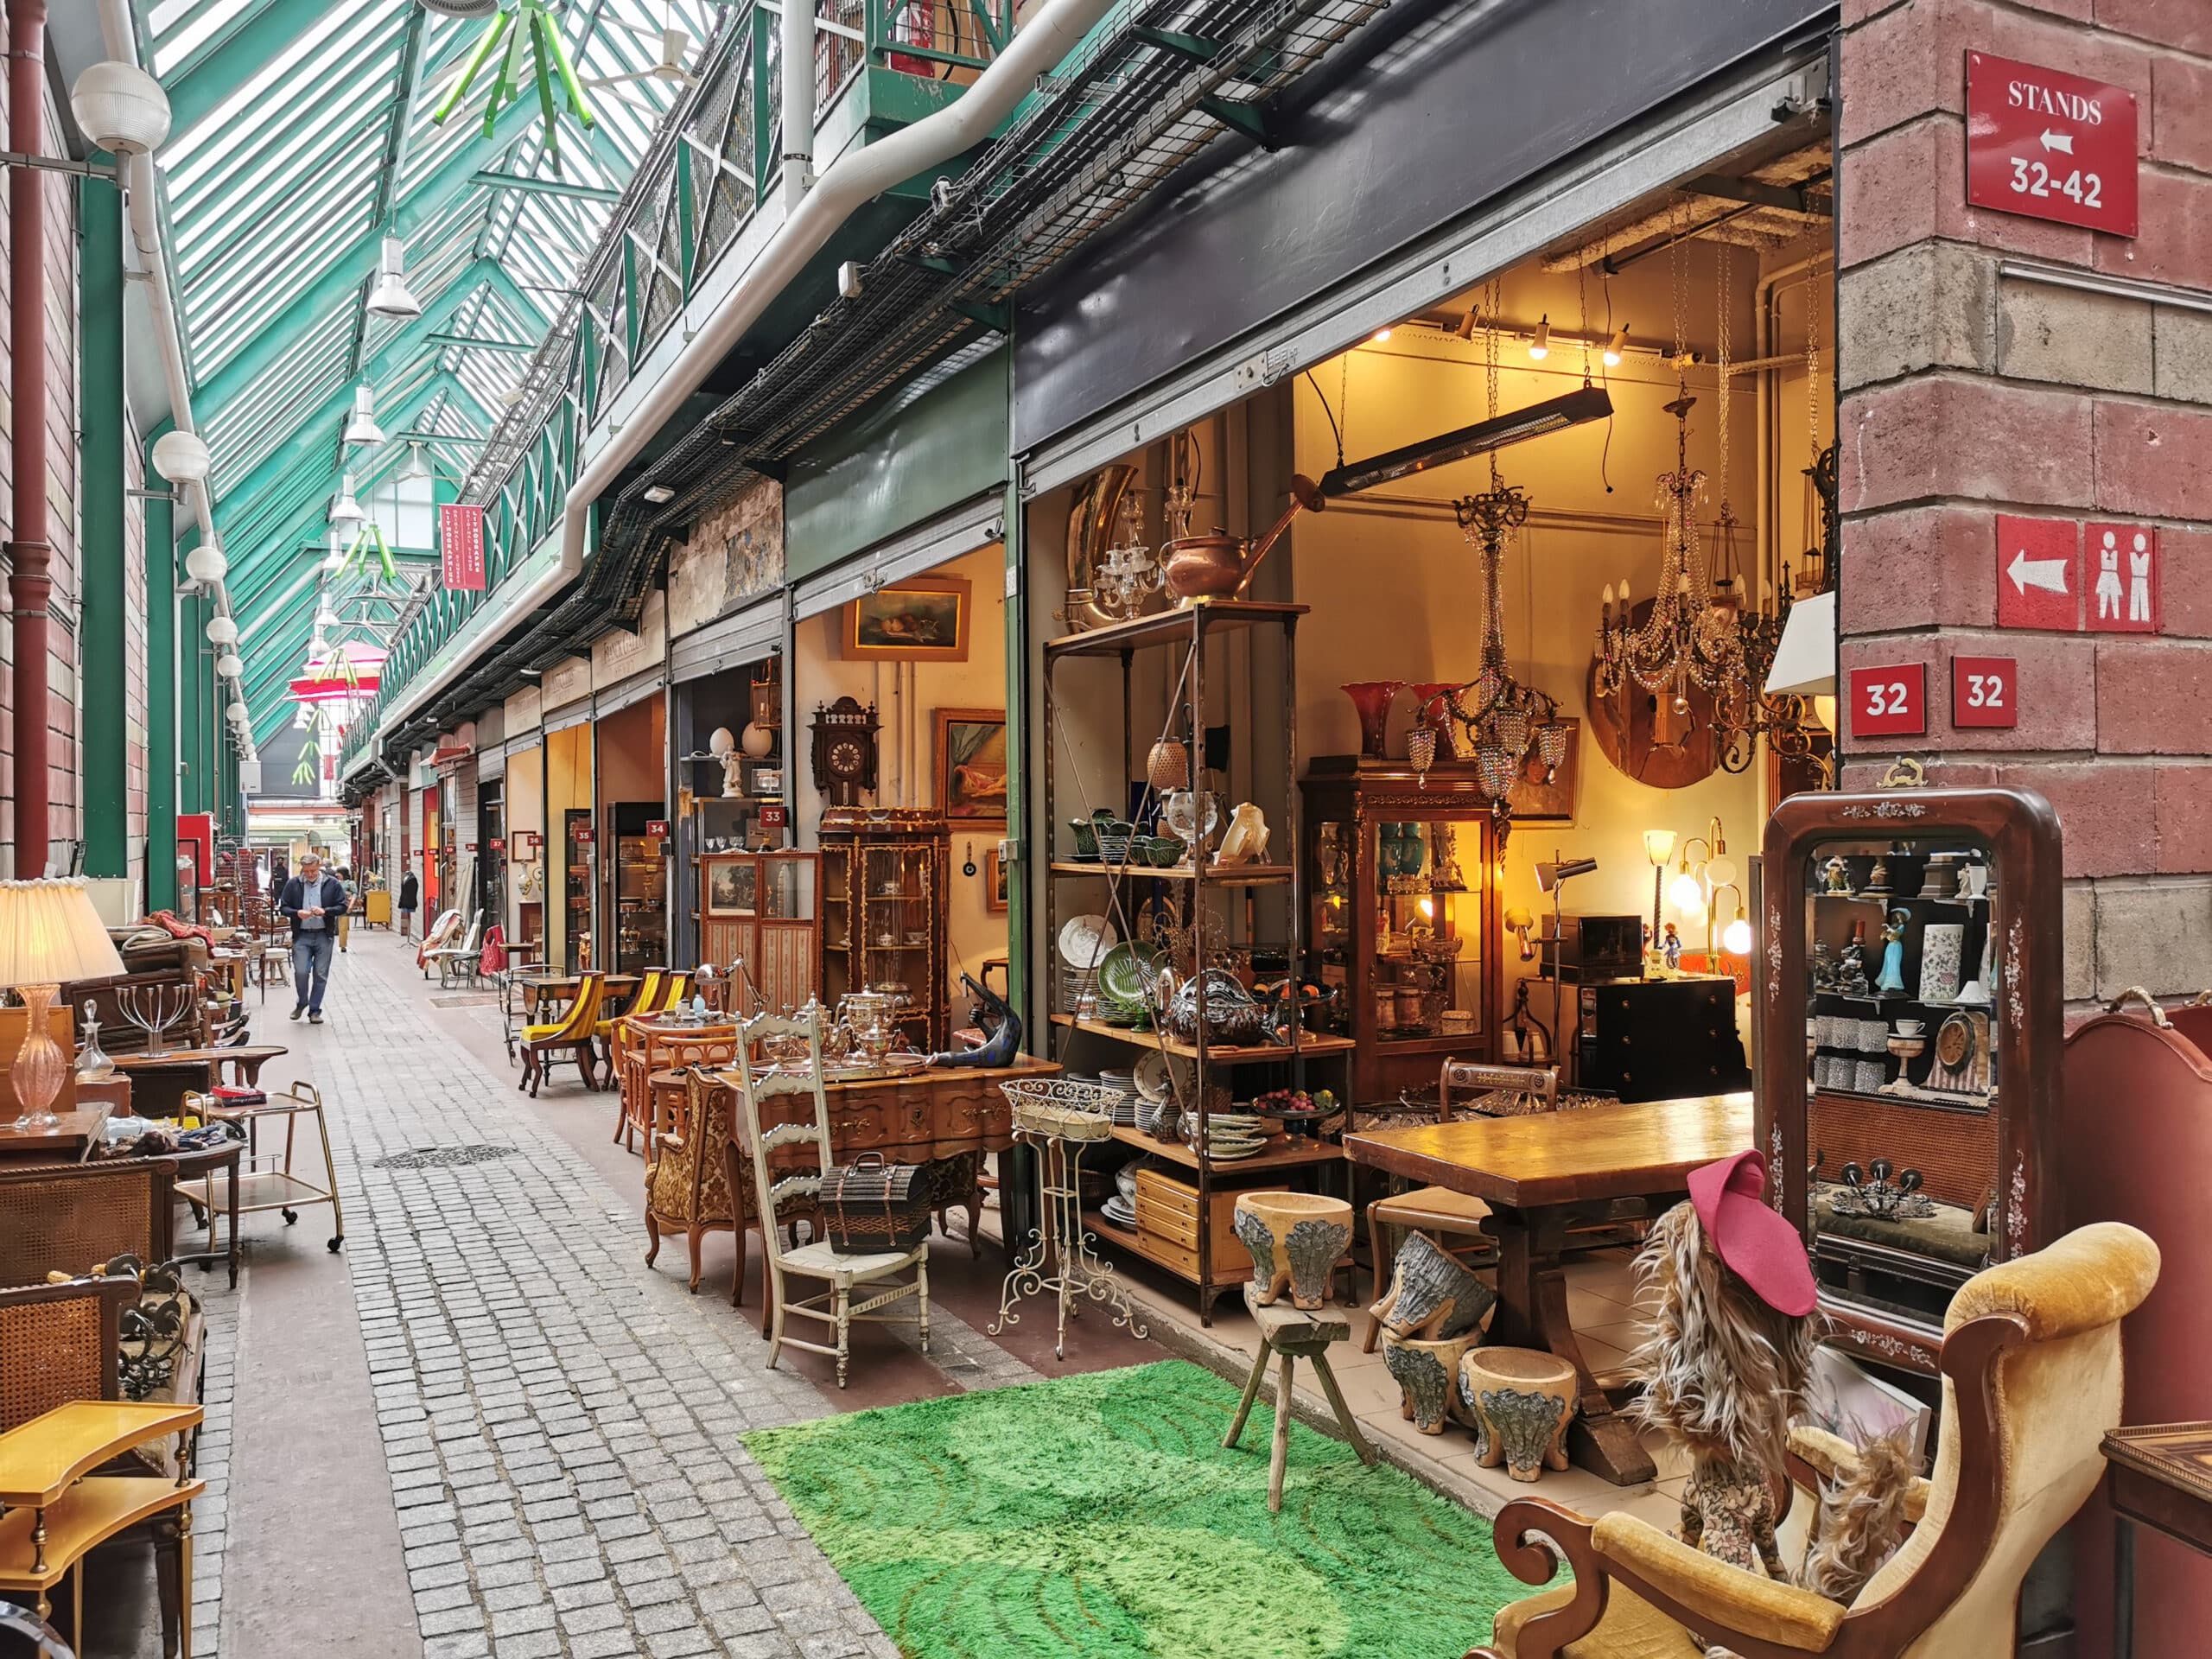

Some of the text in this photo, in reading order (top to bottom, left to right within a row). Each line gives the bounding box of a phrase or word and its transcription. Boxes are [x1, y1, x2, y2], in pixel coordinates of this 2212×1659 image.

[2008, 80, 2101, 125] STANDS
[2010, 156, 2101, 208] 32-42
[445, 509, 454, 583] LITHOGRAPHIES
[1866, 683, 1908, 716] 32
[1967, 675, 2004, 707] 32
[651, 824, 664, 833] 34
[766, 810, 780, 822] 33
